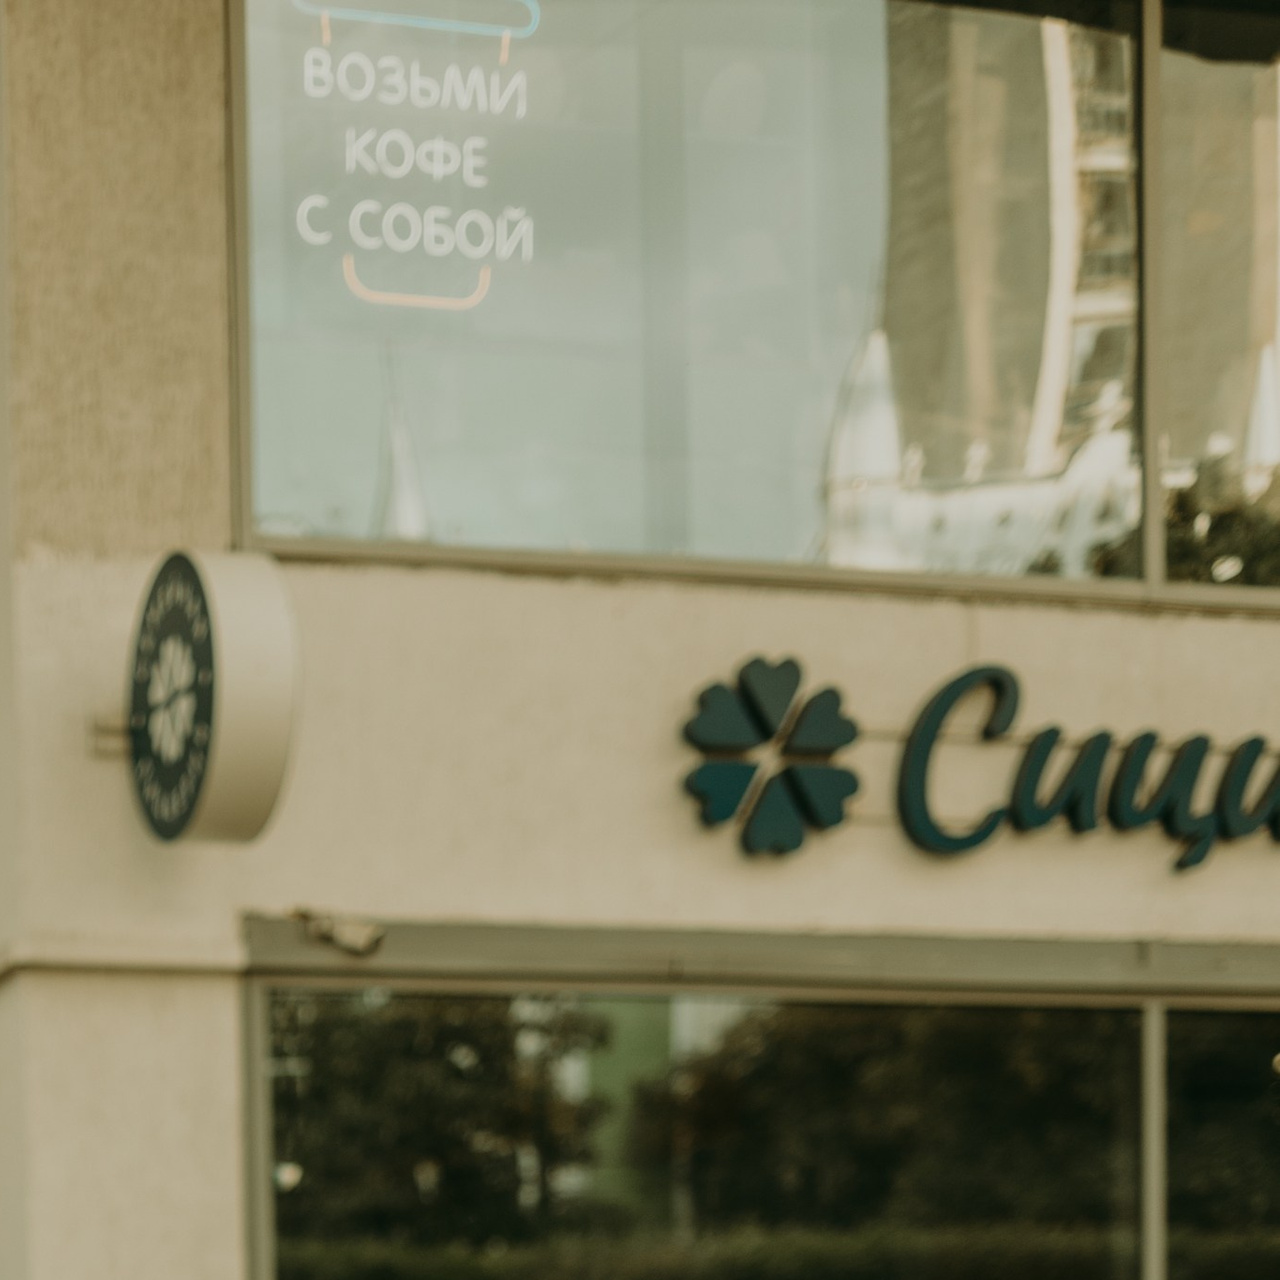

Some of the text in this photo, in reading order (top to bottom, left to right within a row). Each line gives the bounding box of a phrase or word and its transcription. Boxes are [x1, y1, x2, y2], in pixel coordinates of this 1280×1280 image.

[303, 48, 528, 118] ВОЗЬМИ
[344, 128, 488, 187] КОФЕ
[297, 194, 535, 261] С СОБОЙ
